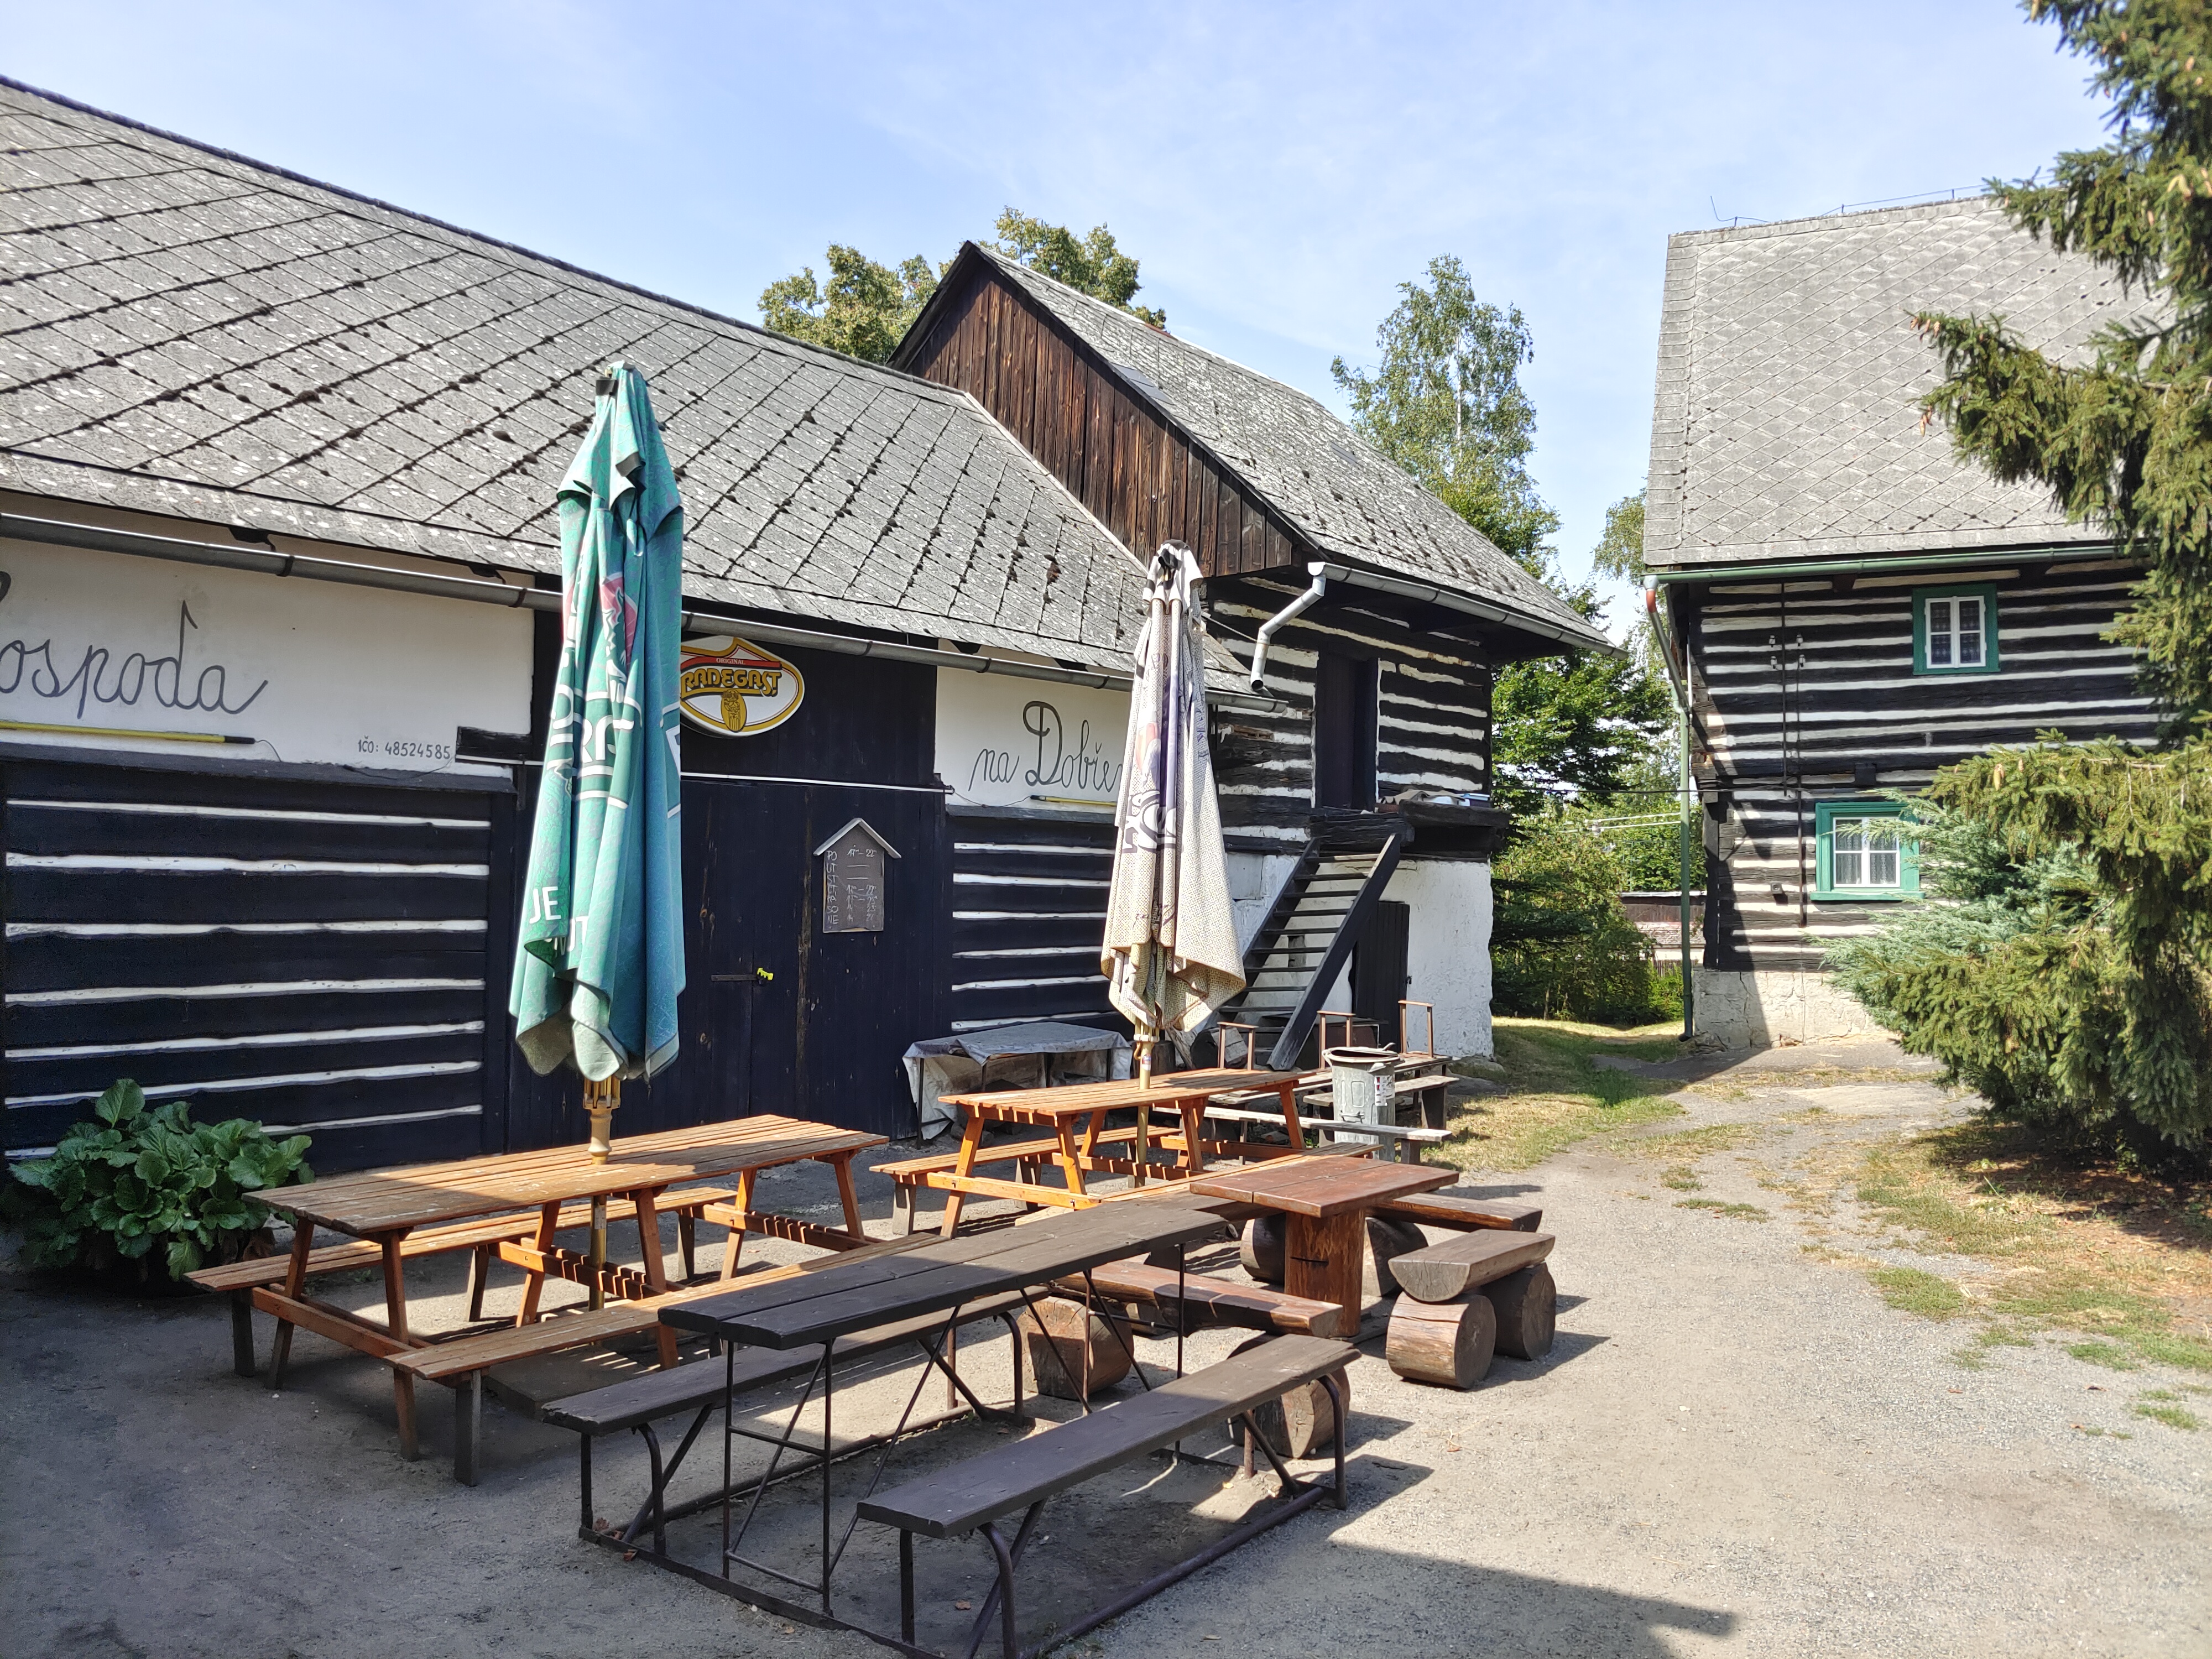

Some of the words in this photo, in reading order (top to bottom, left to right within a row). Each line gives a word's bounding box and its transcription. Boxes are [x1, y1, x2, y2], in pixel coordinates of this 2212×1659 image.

[0, 571, 268, 718] ospoda
[681, 668, 781, 700] RADEGAST
[385, 742, 450, 759] 48524585
[968, 748, 1019, 791] na
[1023, 701, 1123, 792] Dobře
[826, 851, 837, 861] PO
[529, 886, 561, 924] JE
[826, 905, 839, 914] SO
[827, 914, 839, 925] NE
